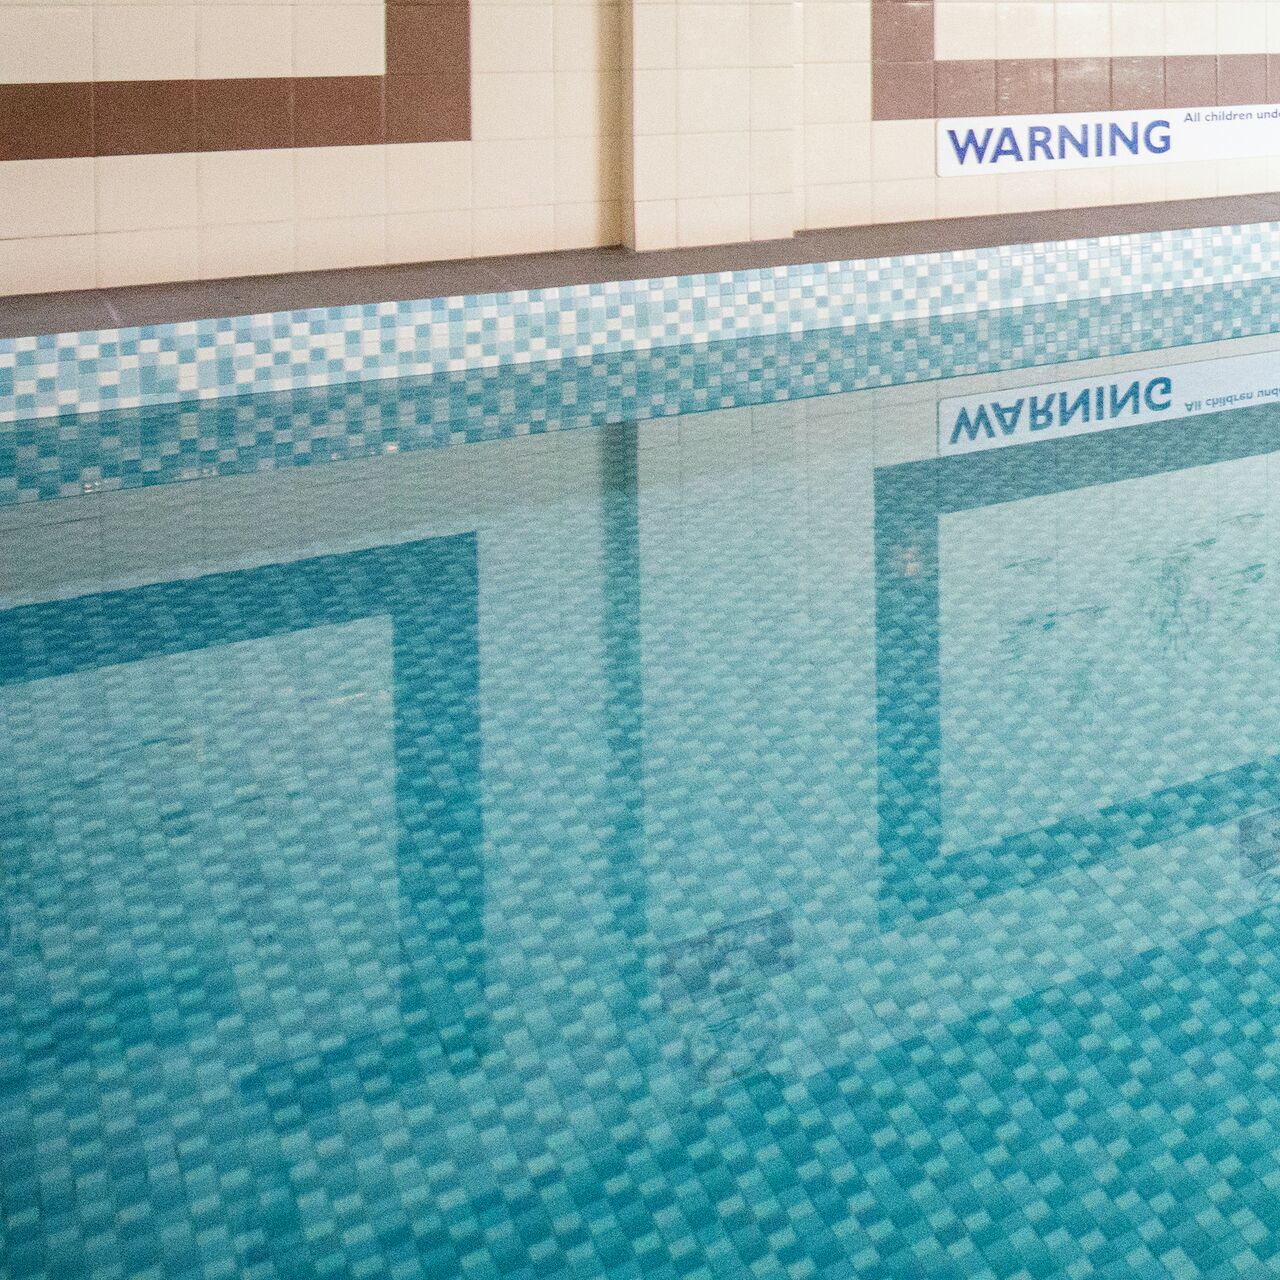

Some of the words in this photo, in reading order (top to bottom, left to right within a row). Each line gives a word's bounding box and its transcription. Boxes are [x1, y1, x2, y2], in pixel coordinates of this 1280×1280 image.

[1183, 111, 1201, 123] All
[1204, 109, 1253, 122] children
[946, 120, 1171, 165] WARNING
